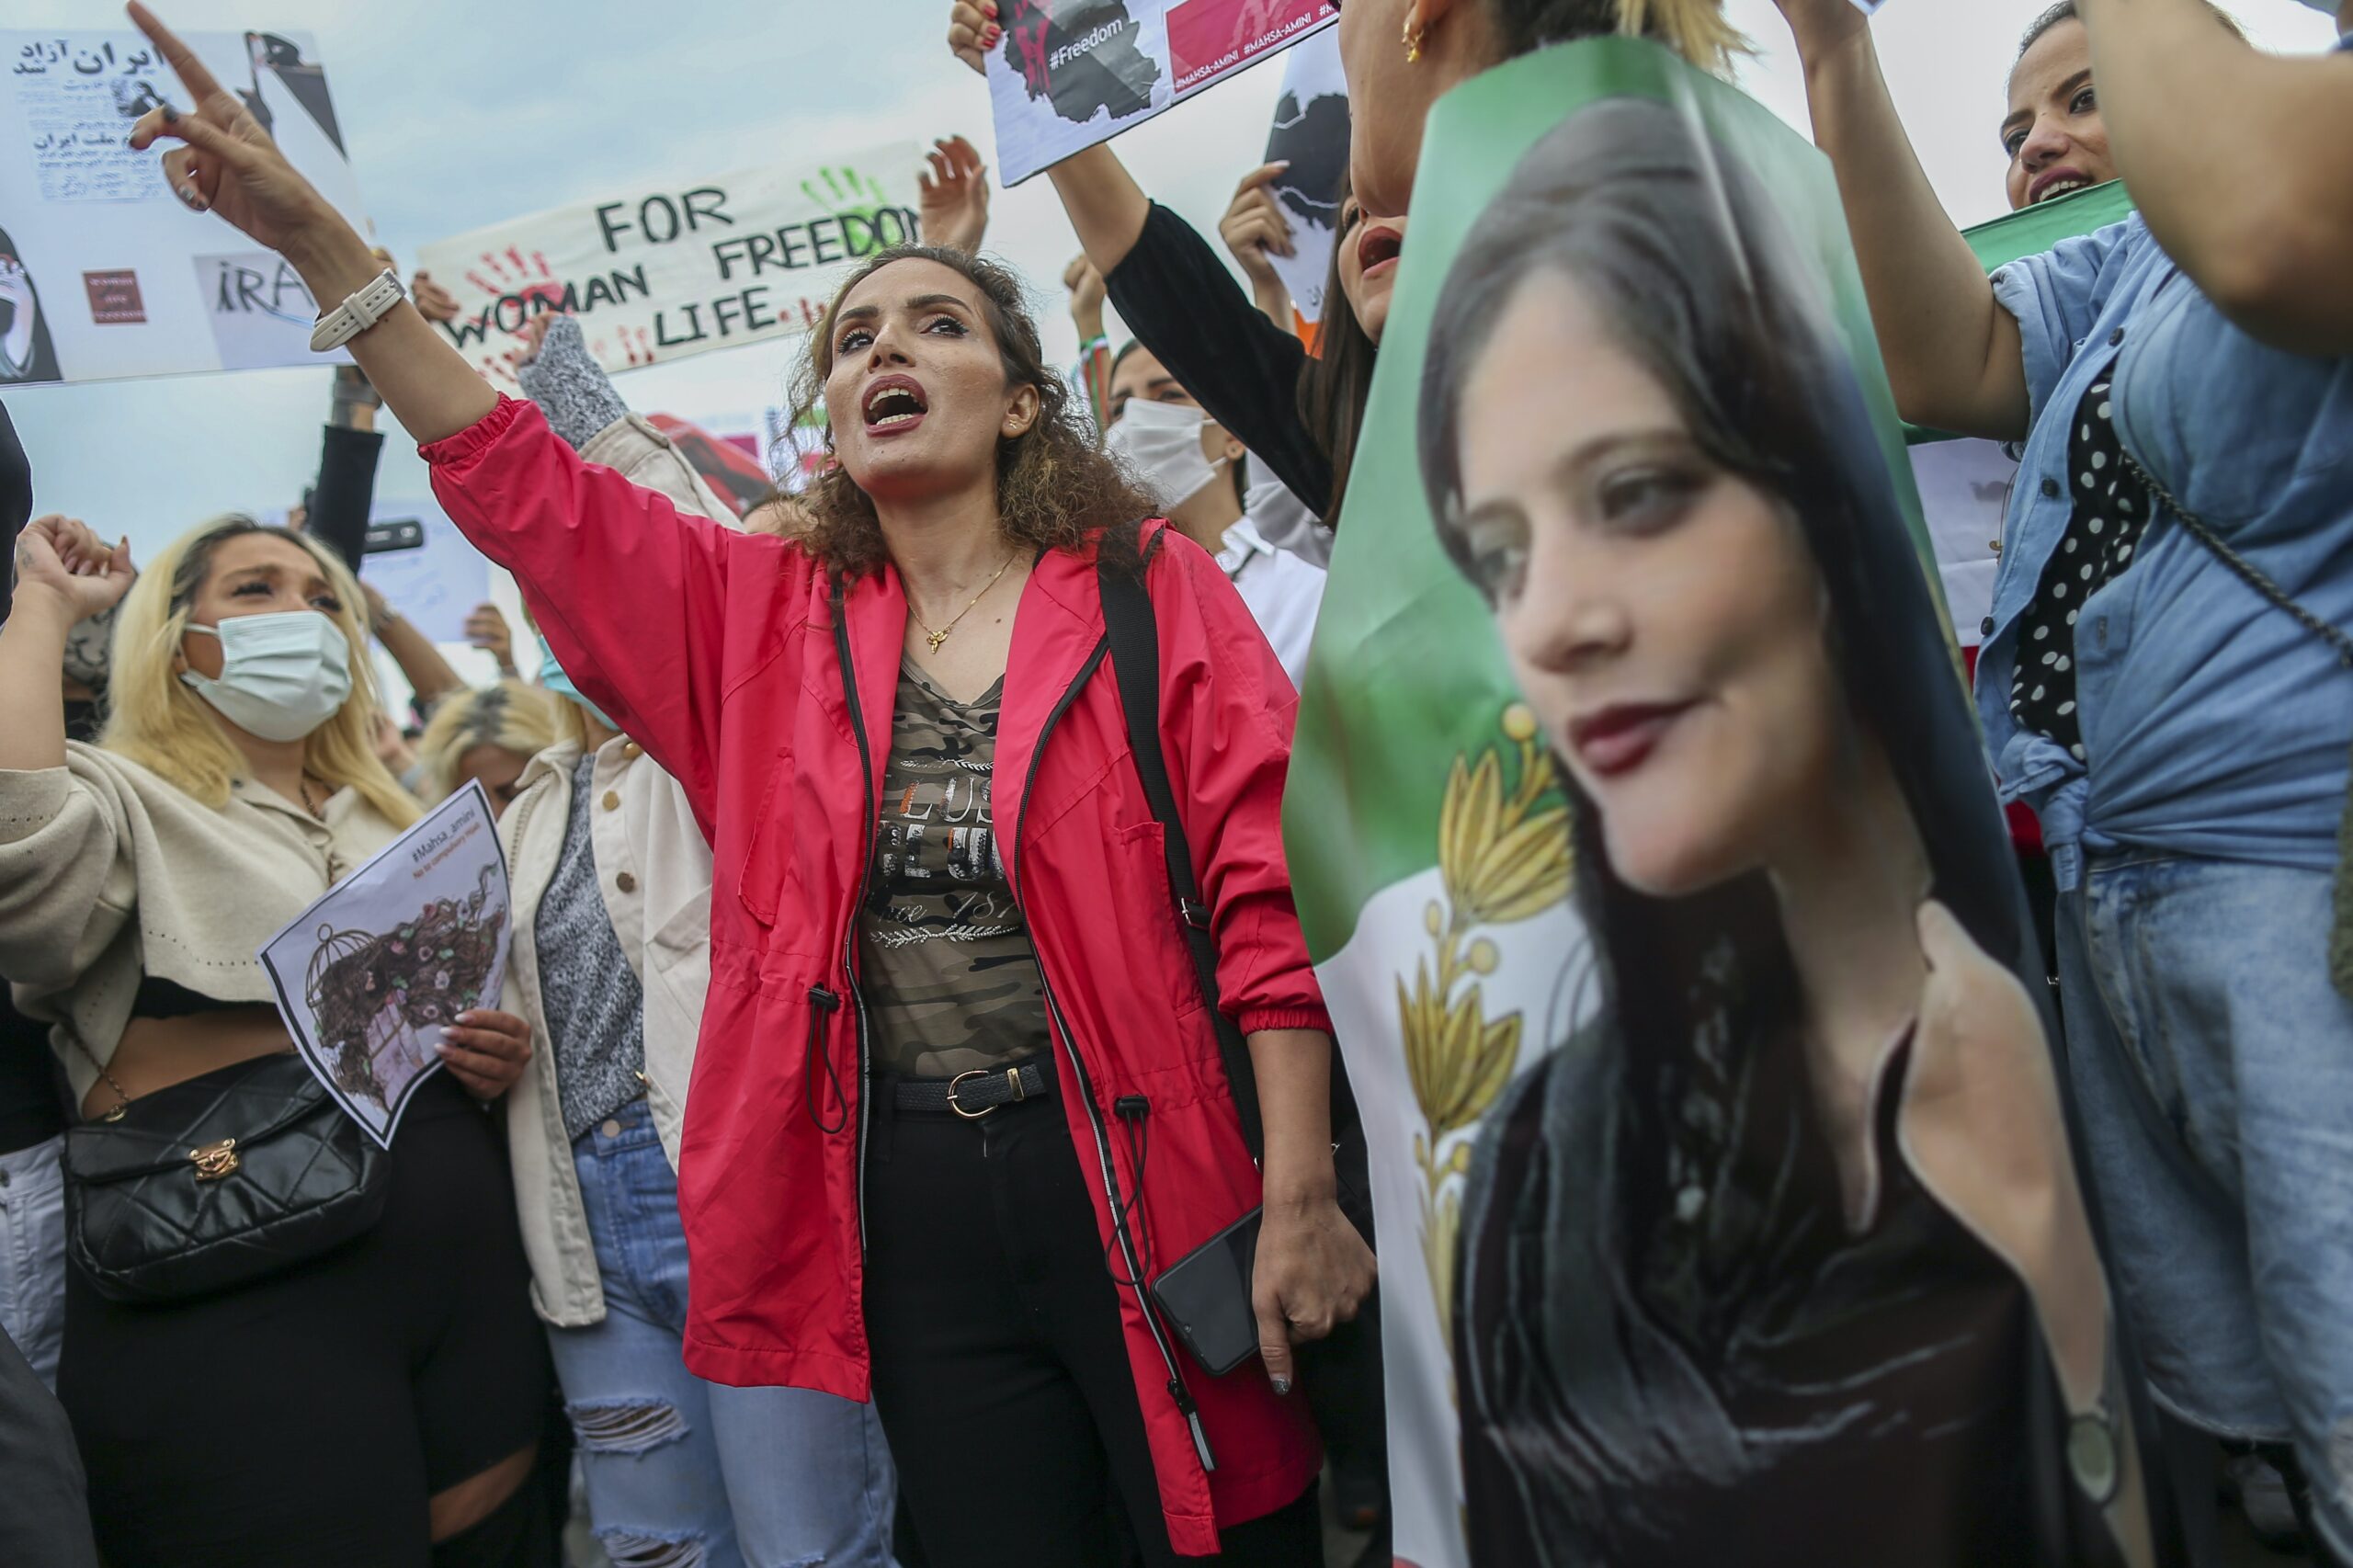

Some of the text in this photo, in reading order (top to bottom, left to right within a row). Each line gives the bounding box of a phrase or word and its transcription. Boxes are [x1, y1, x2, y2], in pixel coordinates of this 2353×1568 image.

[1049, 18, 1123, 71] #Freedom
[1175, 12, 1312, 89] #MAHSA-AMINI #MAHSA-AMINI
[596, 187, 734, 253] FOR
[443, 265, 650, 348] WOMAN
[654, 286, 777, 347] LIFE
